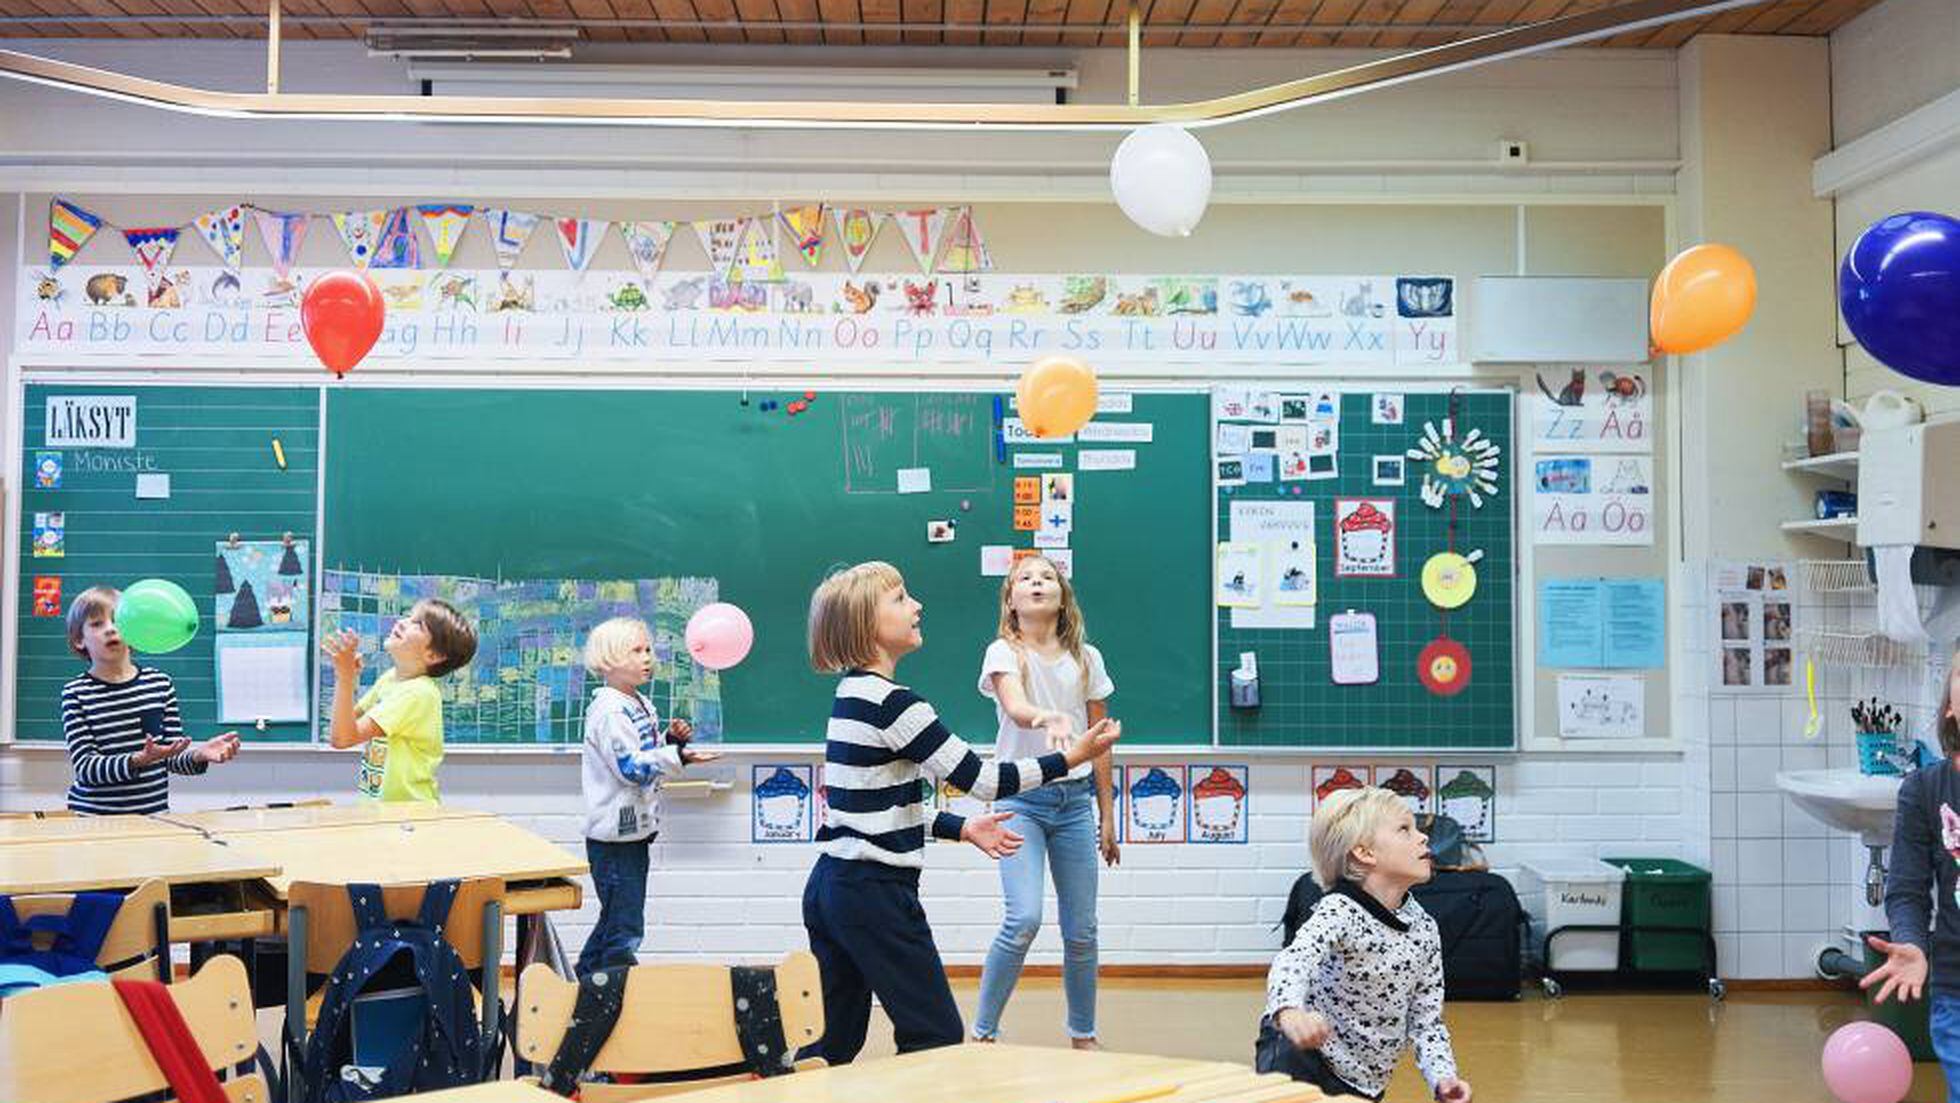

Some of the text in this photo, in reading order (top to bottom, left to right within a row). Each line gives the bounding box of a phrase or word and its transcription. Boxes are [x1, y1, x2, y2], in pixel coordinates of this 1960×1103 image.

[30, 310, 74, 342] Aa
[89, 312, 132, 342] Bb
[149, 313, 190, 343] Cc
[204, 312, 250, 342] Dd
[264, 312, 301, 342] Ee
[433, 314, 476, 344] Hh
[556, 317, 586, 354] Jj
[611, 318, 650, 348] Kk
[709, 317, 771, 348] Mm
[780, 318, 824, 348] Nn
[834, 318, 880, 349] Oo
[895, 318, 935, 357] Pp
[947, 318, 992, 356] Qq
[1010, 320, 1045, 350] Rr
[1062, 320, 1102, 350] Ss
[1124, 320, 1154, 351] Tt
[1173, 321, 1218, 351] Uu
[1232, 321, 1270, 352] Vv
[1277, 321, 1331, 352] Ww
[1343, 321, 1384, 352] Xx
[1410, 322, 1447, 360] Yy
[50, 400, 131, 441] LÄKSYT
[1546, 408, 1583, 440] Zz
